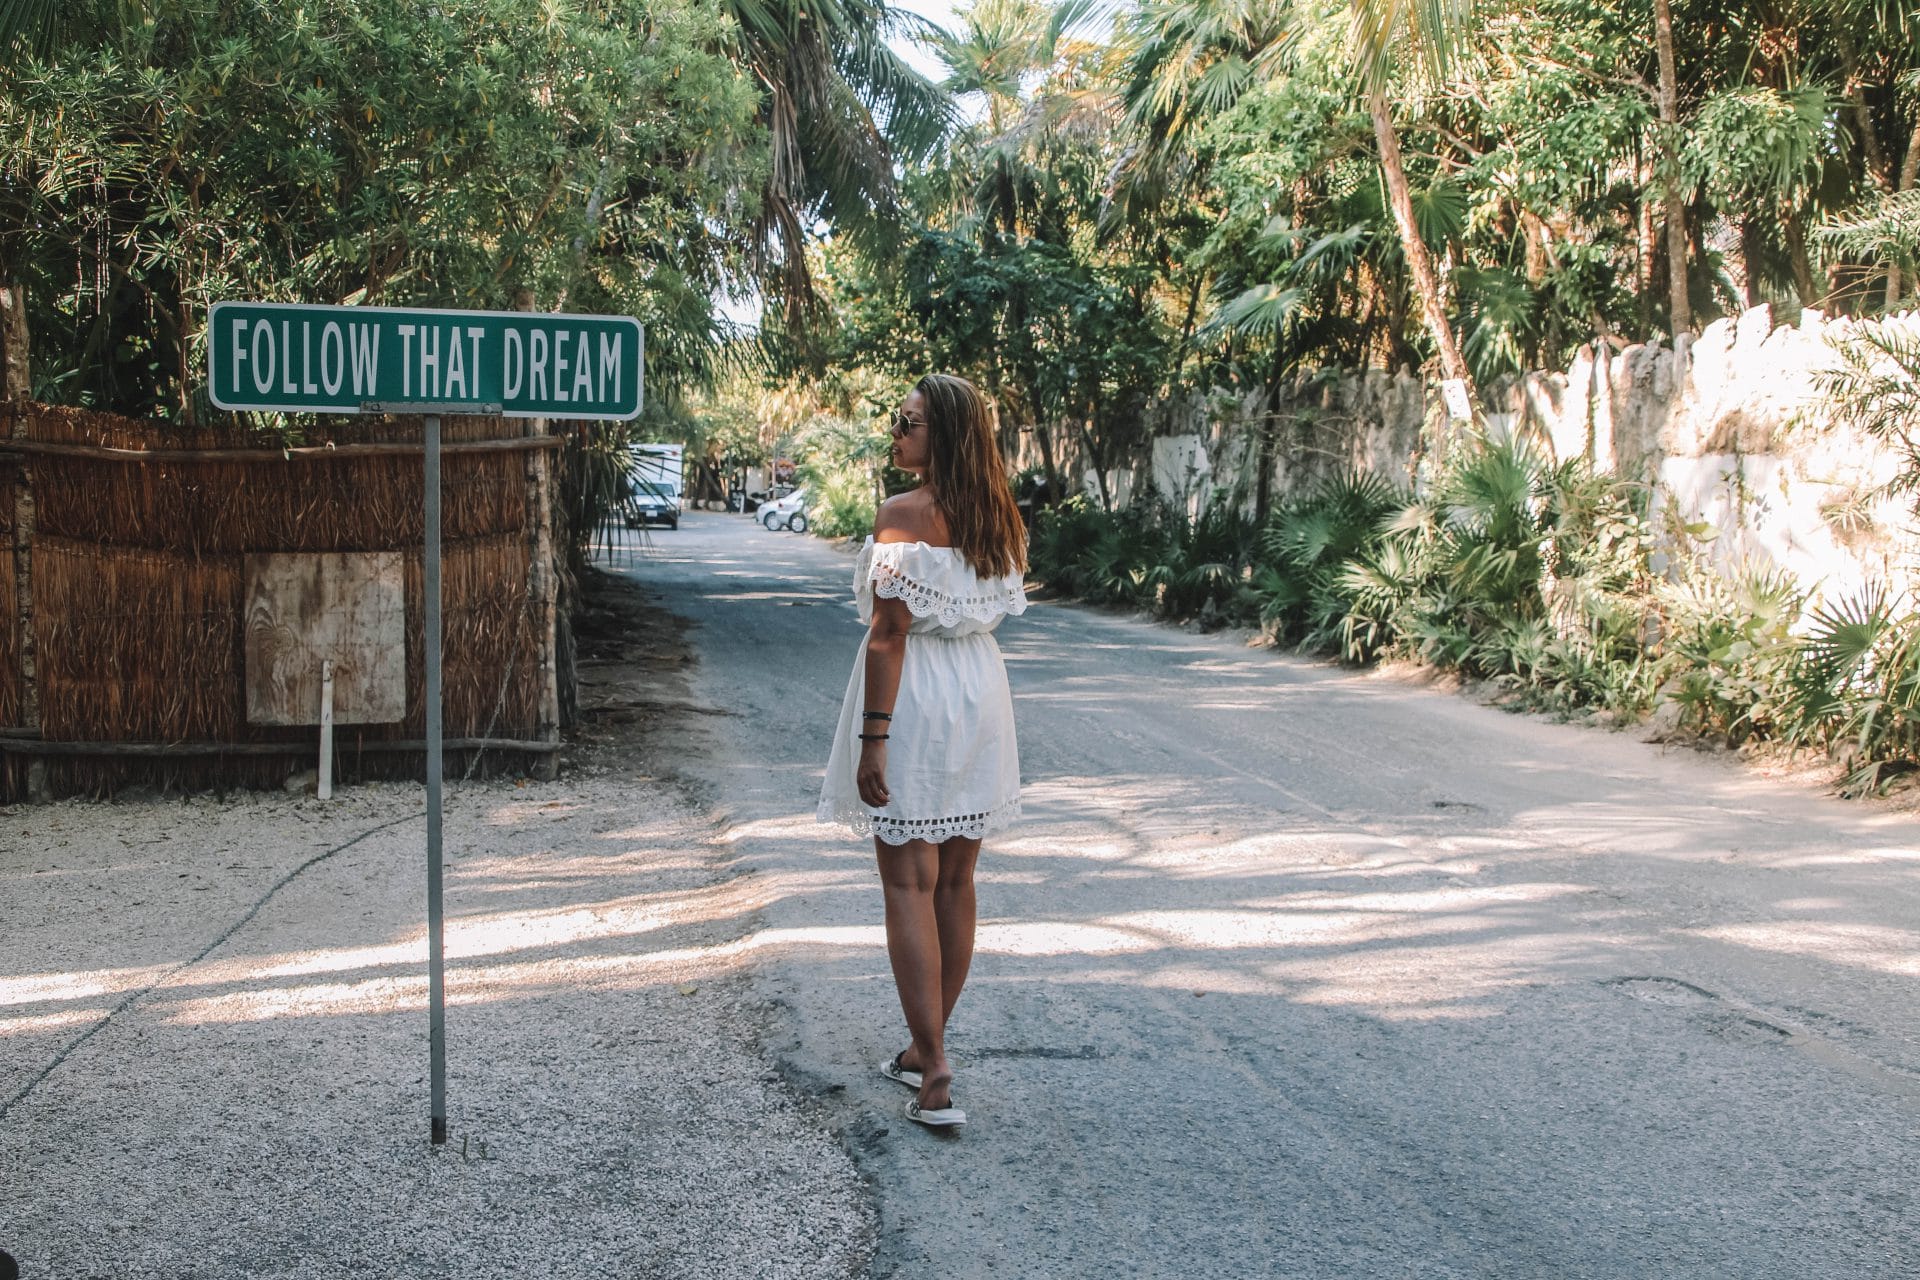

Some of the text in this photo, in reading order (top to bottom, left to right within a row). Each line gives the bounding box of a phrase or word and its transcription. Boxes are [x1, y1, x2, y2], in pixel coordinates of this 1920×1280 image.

[232, 318, 622, 403] FOLLOW THAT DREAM
